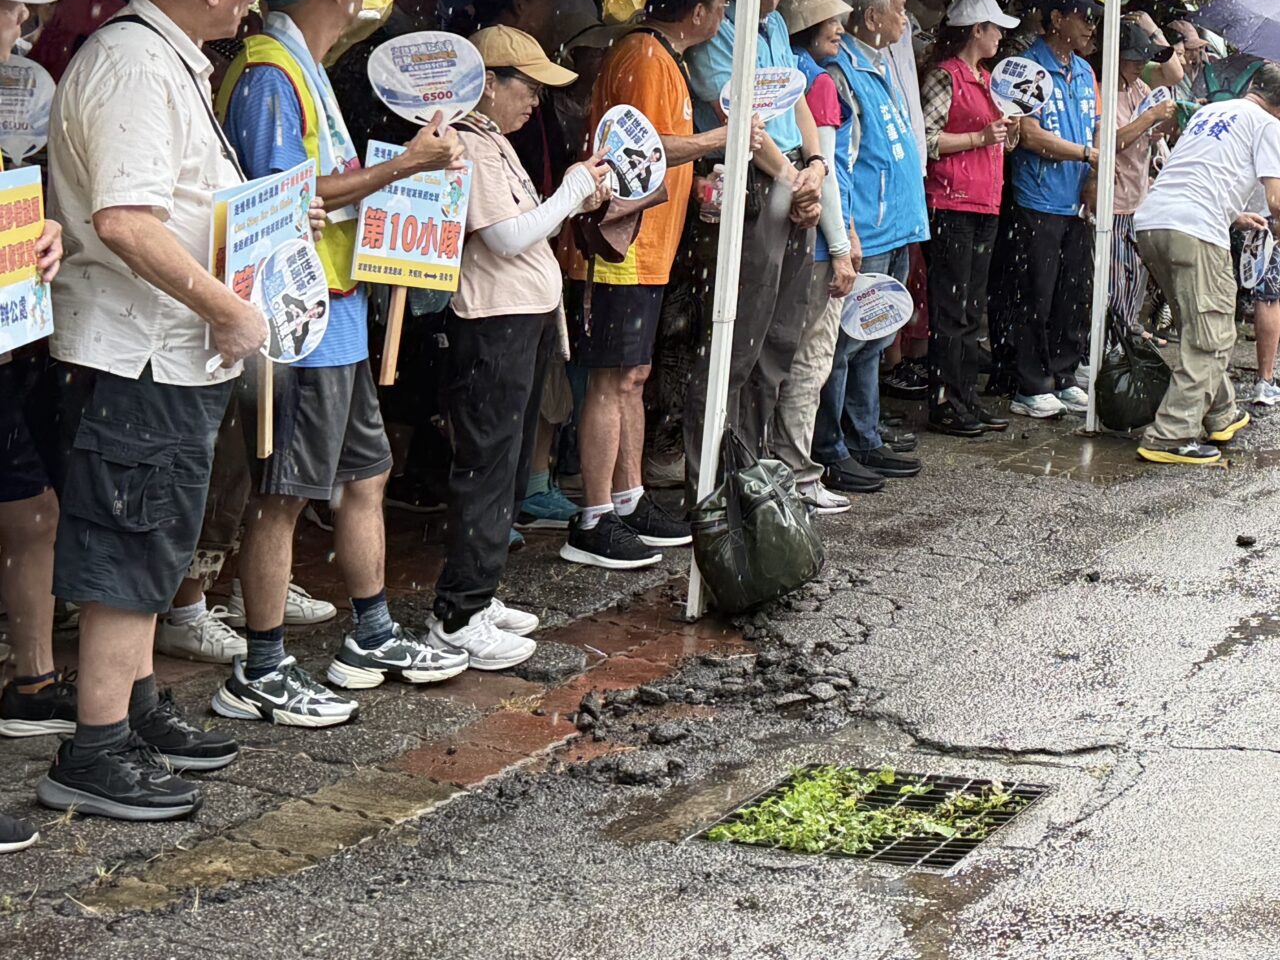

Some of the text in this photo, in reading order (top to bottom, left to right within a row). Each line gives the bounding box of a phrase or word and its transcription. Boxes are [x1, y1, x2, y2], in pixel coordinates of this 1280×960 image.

[422, 90, 453, 102] 6500
[623, 108, 649, 139] 新世代
[361, 206, 462, 260] 第10小隊
[296, 245, 317, 286] 新世代
